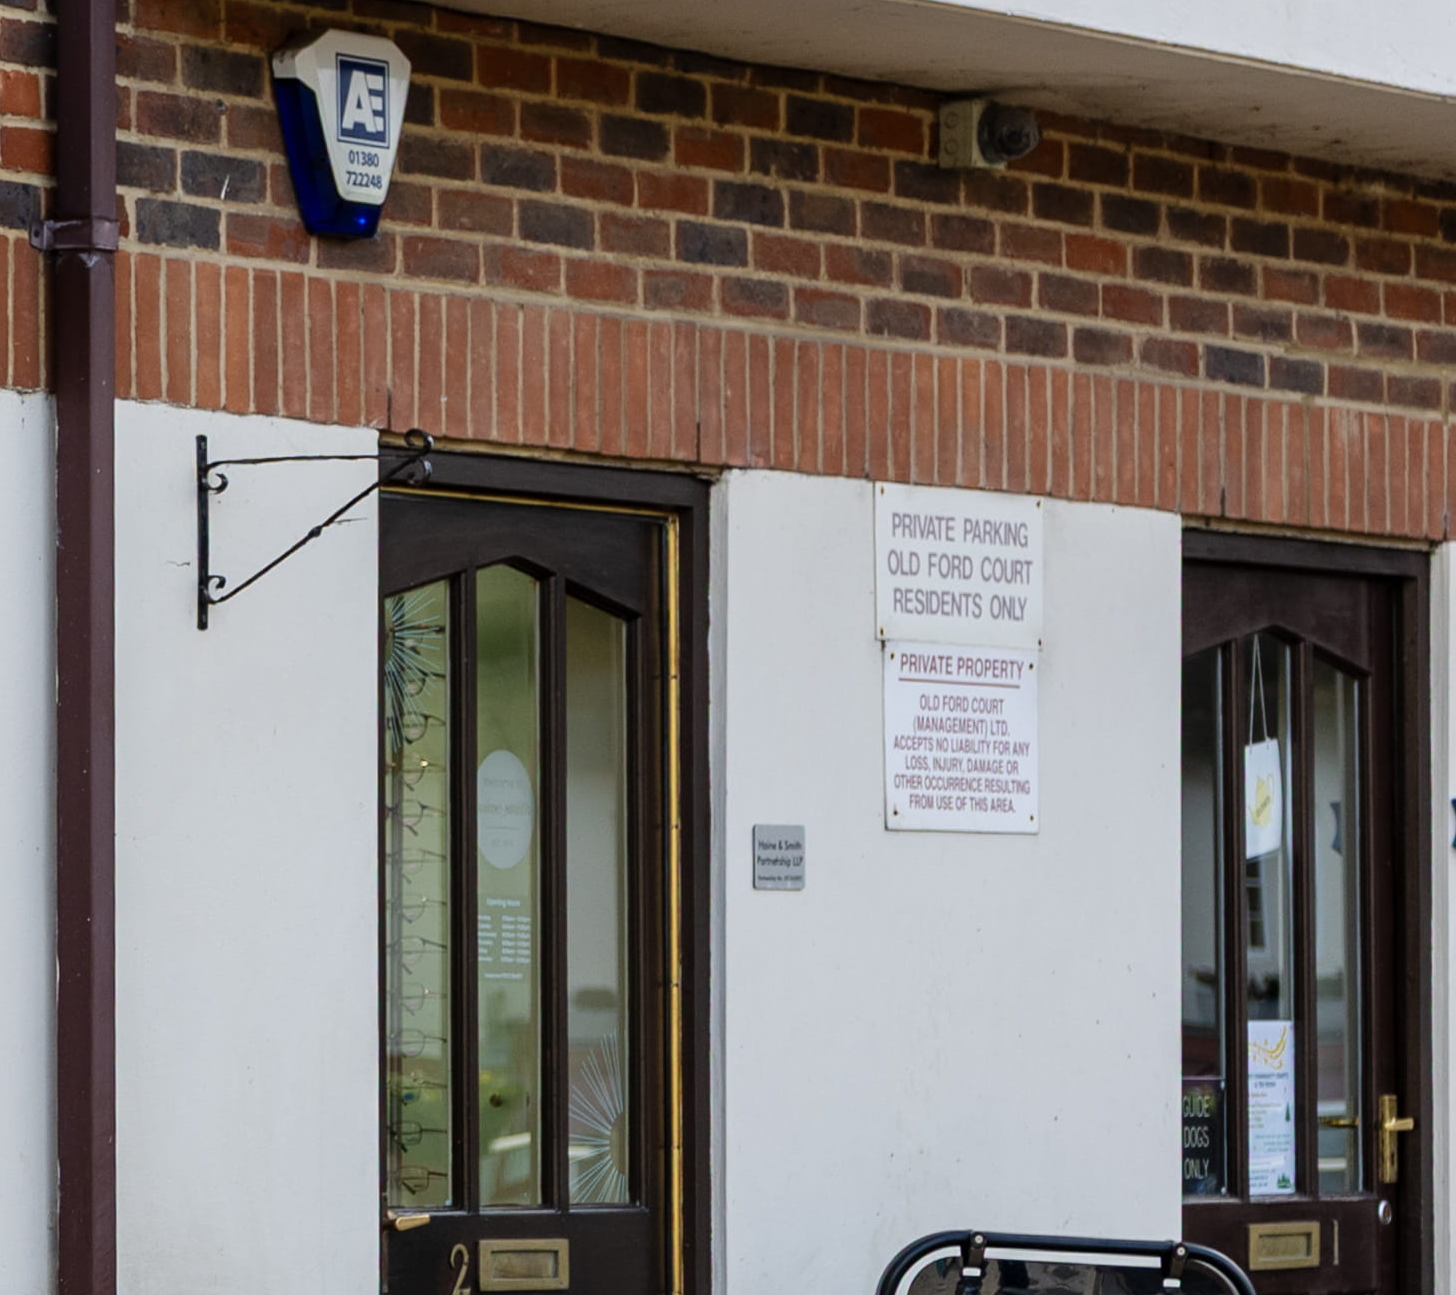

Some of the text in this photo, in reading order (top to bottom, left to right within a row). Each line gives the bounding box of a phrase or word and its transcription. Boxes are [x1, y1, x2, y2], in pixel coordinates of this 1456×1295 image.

[348, 149, 379, 168] 01380
[345, 170, 383, 190] 722248
[892, 512, 1028, 548] PRIVATE PARKING
[888, 549, 1033, 585] OLD FORD COURT
[893, 588, 1027, 621] RESIDENTS ONLY
[900, 653, 1024, 680] PRIVATE PROPERTY
[919, 694, 1004, 715] OLD FORD COURT
[913, 715, 1010, 738] (MANAGEMENT) LTD.
[893, 735, 1030, 757] ACCEPTS NO LIABILITY FOR ANY
[905, 755, 1019, 776] LOSS, INJURY, DAMAGE OR
[894, 774, 1031, 795] OTHER OCCURRENCE RESULTING
[909, 793, 935, 810] FROM
[936, 794, 953, 811] USE
[955, 796, 967, 811] OF
[969, 797, 988, 812] THIS
[1183, 1094, 1211, 1118] GUIDE
[1183, 1126, 1210, 1148] DOGS
[1184, 1158, 1210, 1180] ONLY
